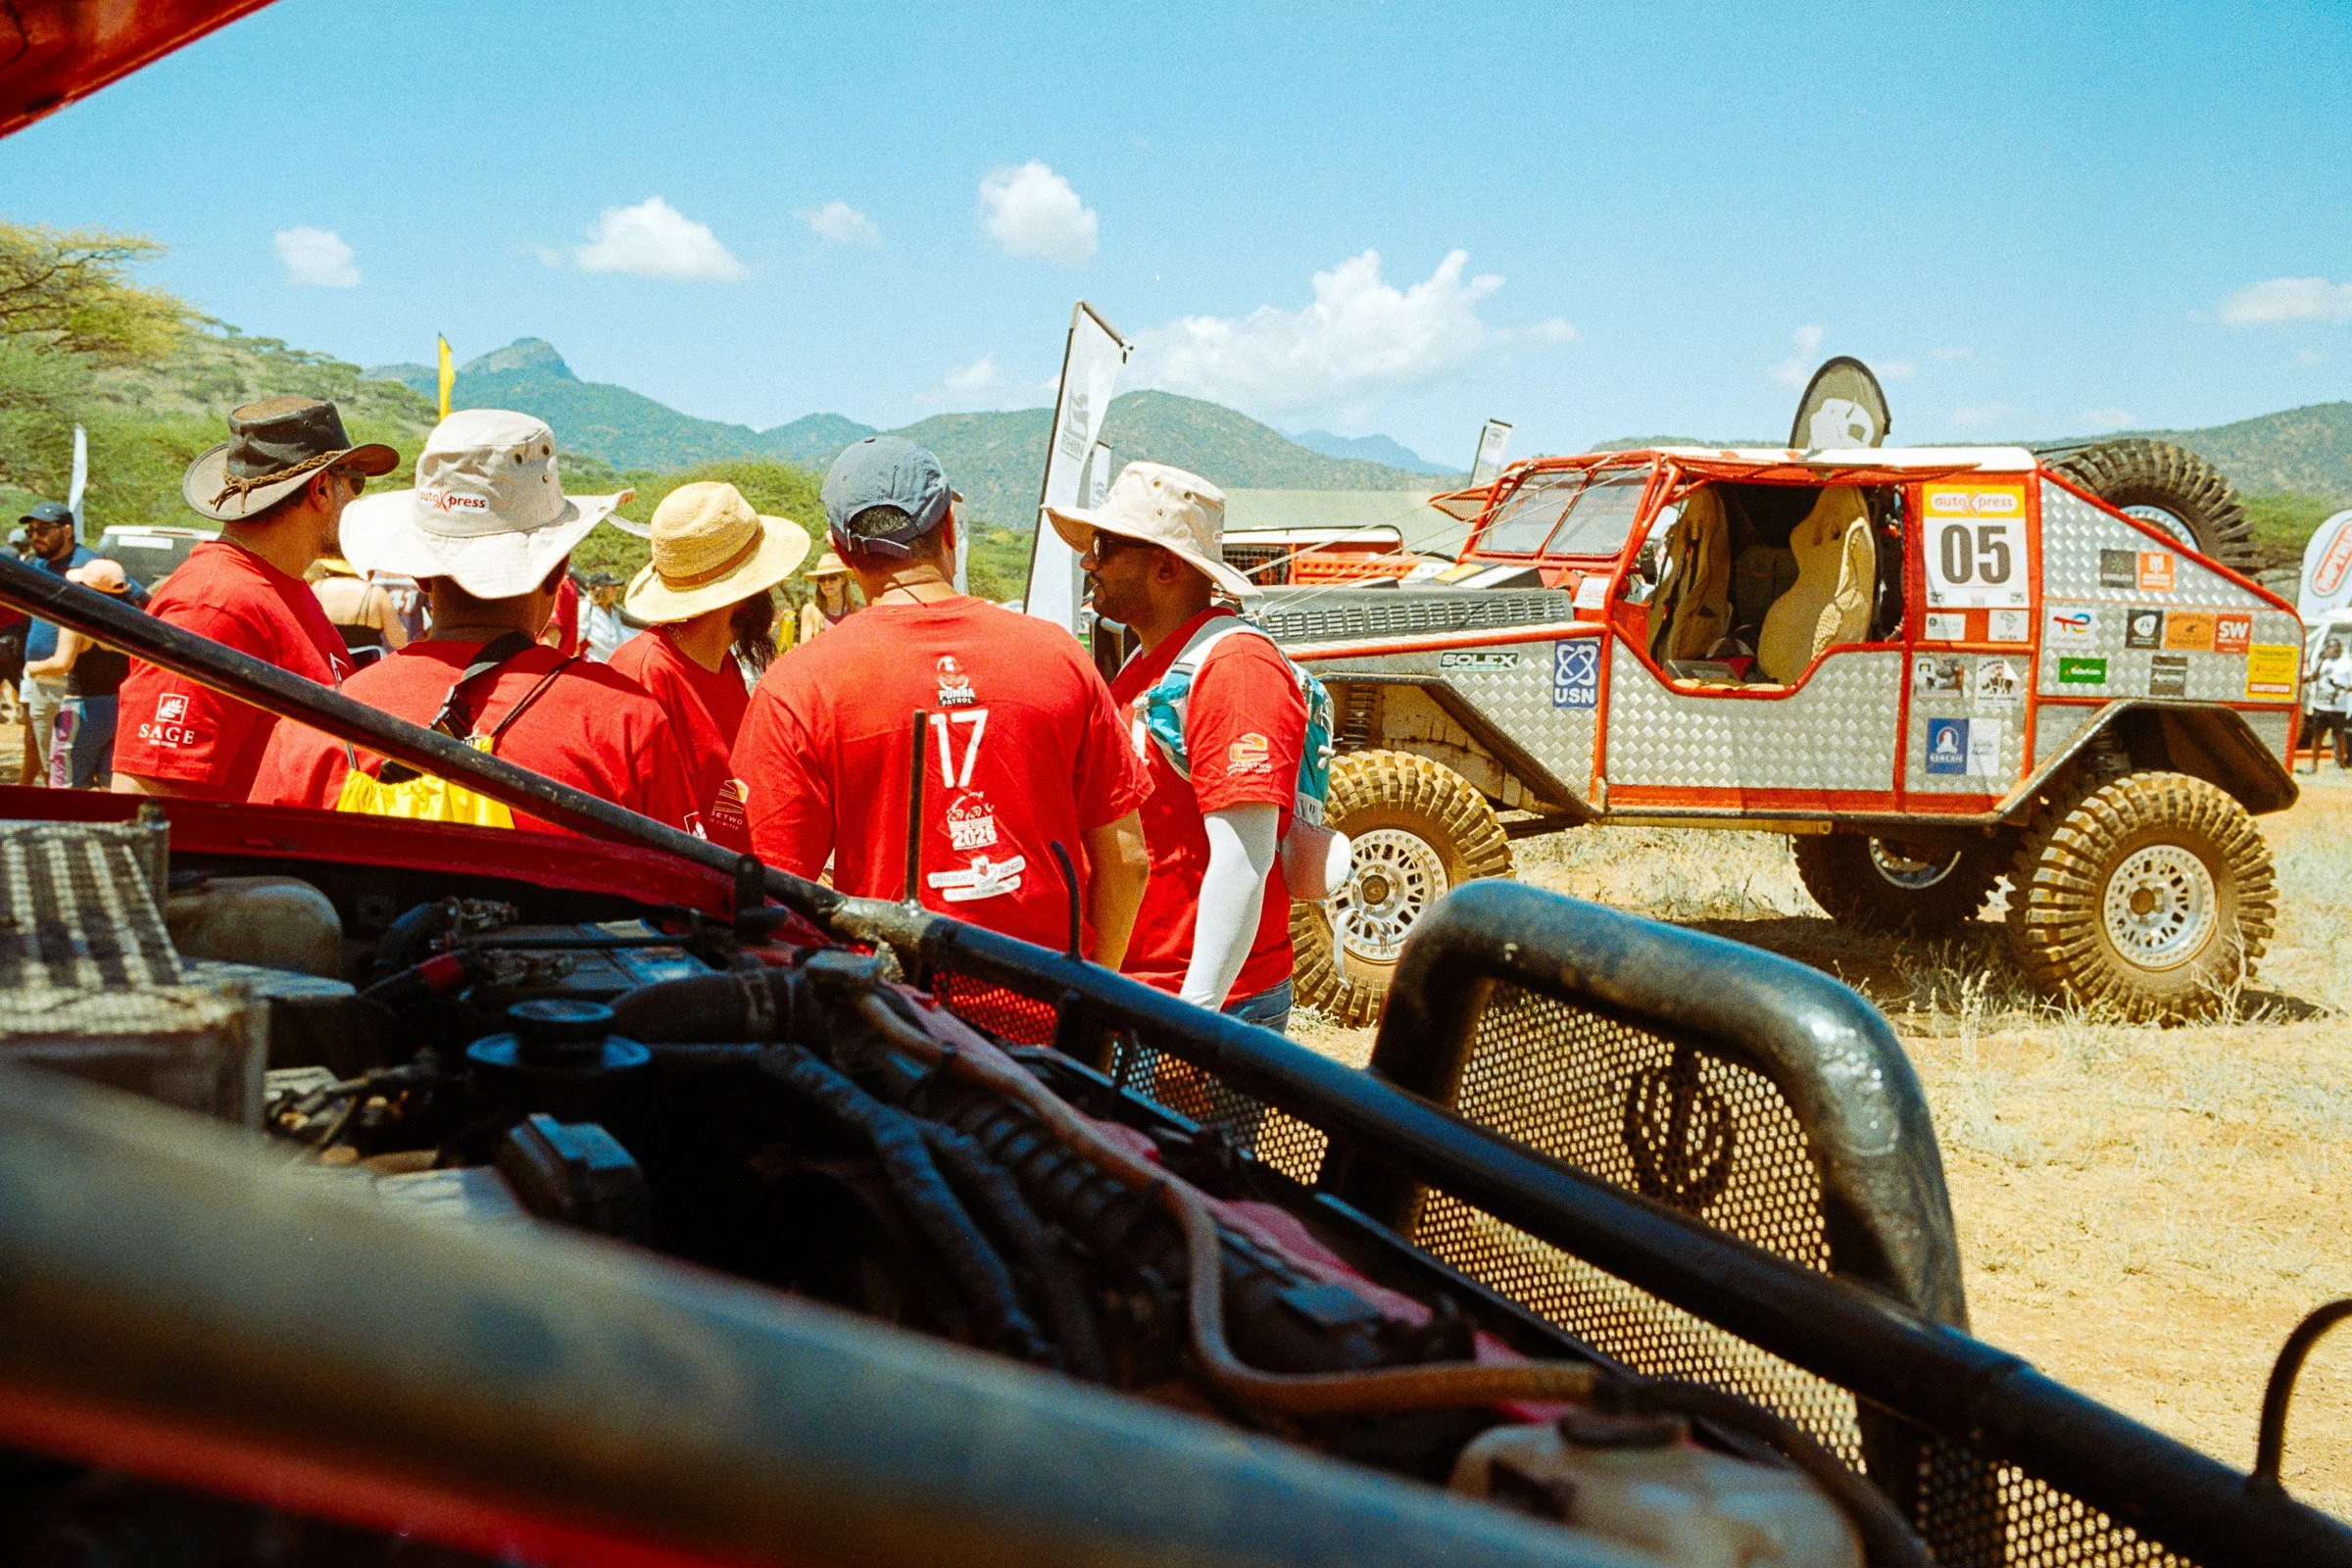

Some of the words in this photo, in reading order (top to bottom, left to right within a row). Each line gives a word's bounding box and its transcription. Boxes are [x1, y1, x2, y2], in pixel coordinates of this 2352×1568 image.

[419, 489, 486, 513] autoXpress
[1935, 491, 2014, 515] autoXpress
[1940, 523, 2011, 585] 05
[2218, 619, 2249, 640] SW
[1442, 654, 1518, 668] SOLEX
[938, 687, 976, 701] PUMBA
[942, 697, 973, 707] PATROL
[1553, 687, 1595, 705] USN
[138, 723, 195, 745] SAGE
[929, 709, 989, 789] 17
[710, 810, 743, 825] SETWO
[951, 825, 998, 849] 2026
[932, 872, 973, 885] PROMO
[1000, 859, 1023, 874] KINGS
